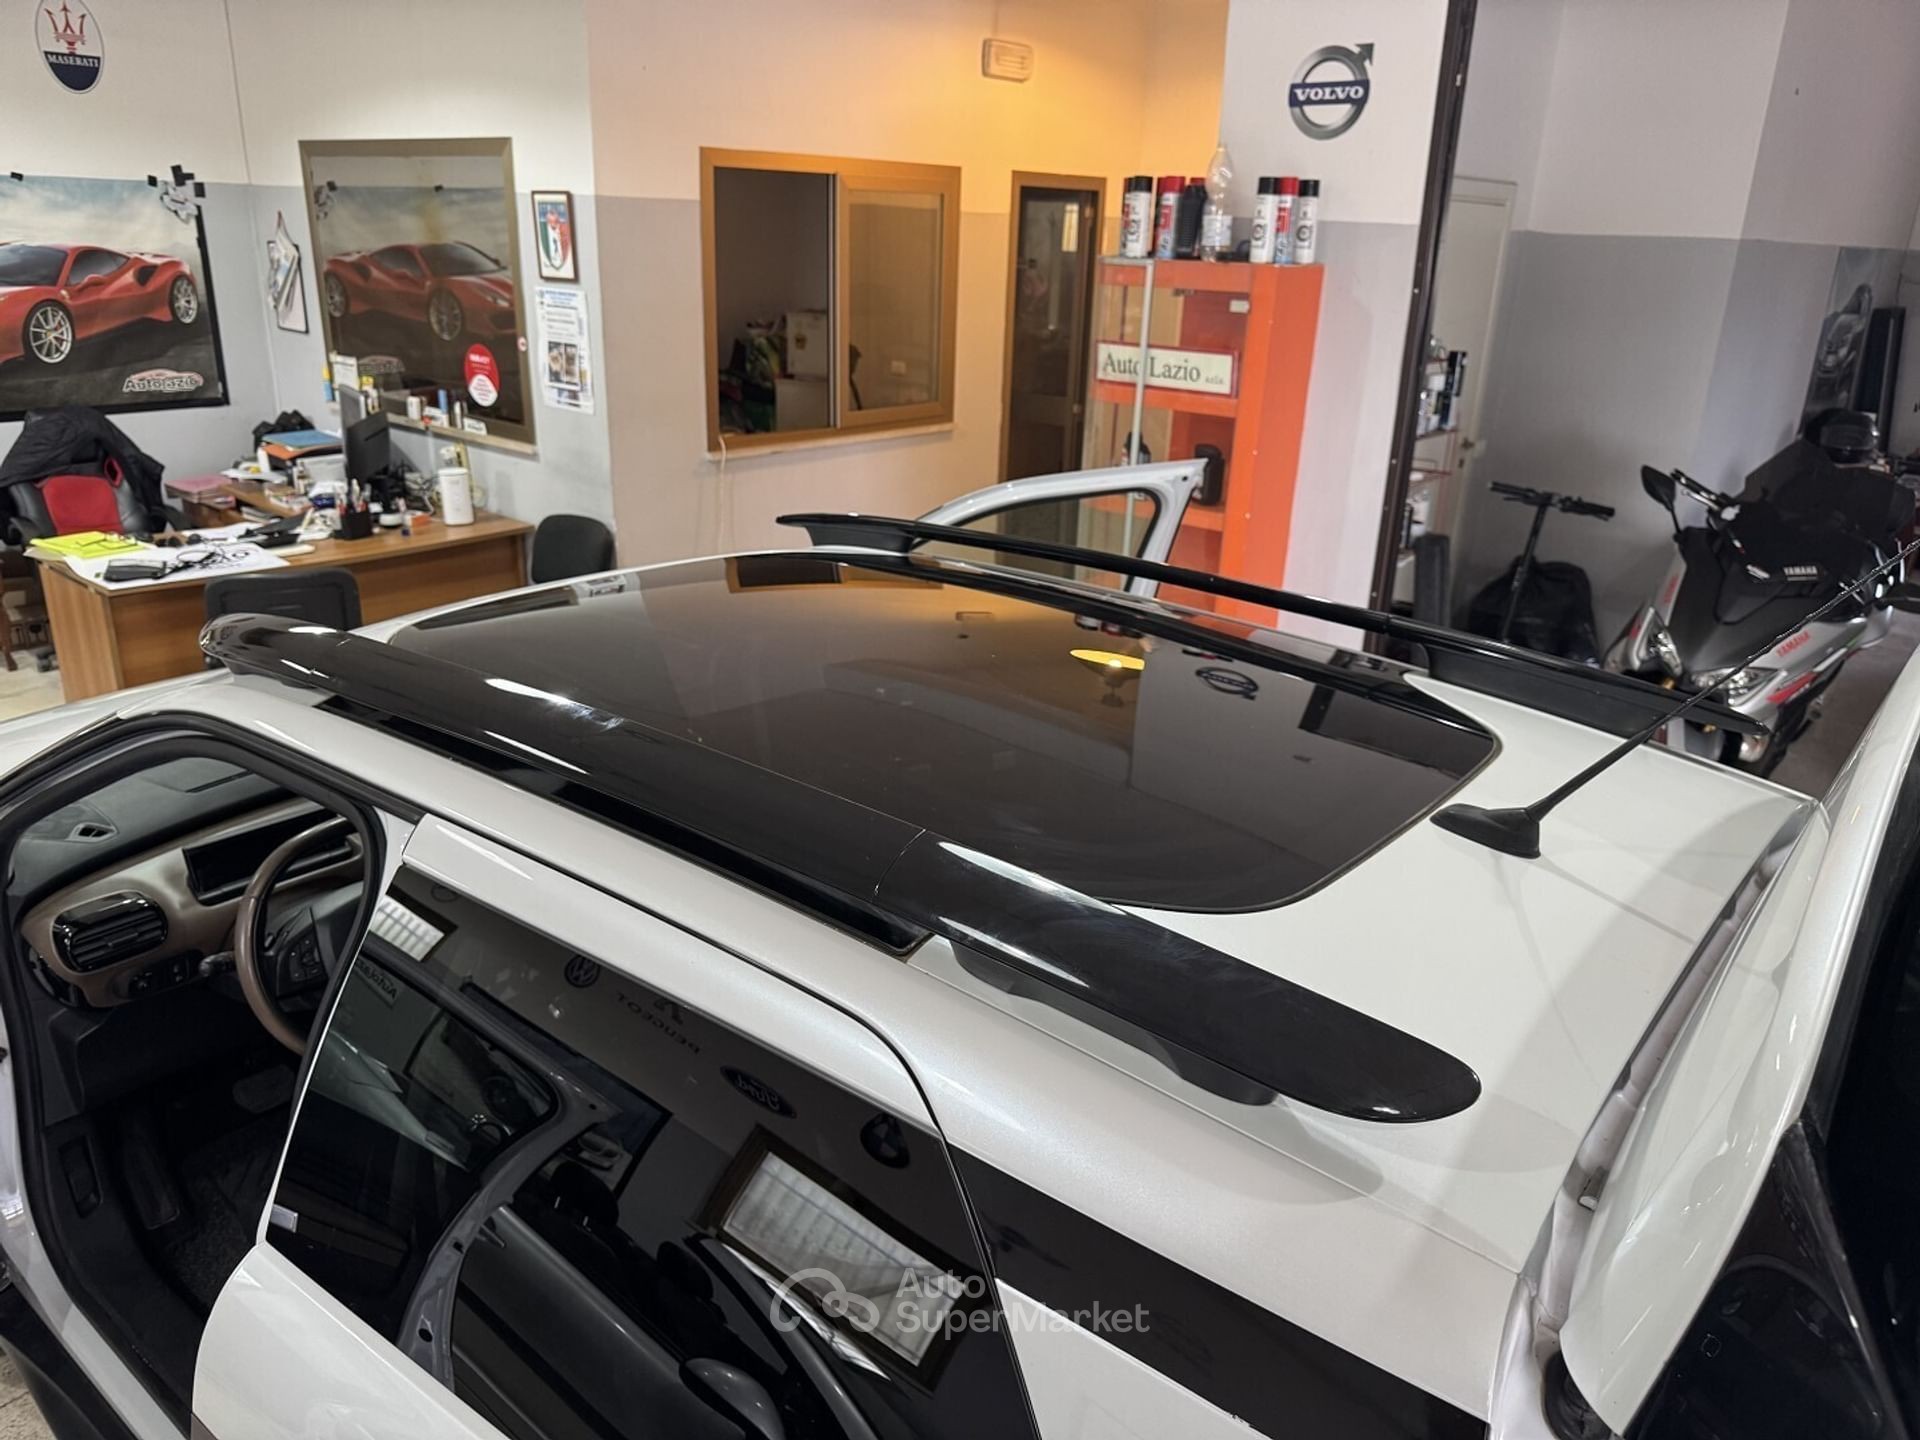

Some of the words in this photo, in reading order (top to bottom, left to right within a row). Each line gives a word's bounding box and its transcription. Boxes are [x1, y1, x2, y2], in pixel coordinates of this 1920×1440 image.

[46, 53, 99, 67] MASERATI
[1293, 85, 1364, 101] VOLVO
[1150, 356, 1201, 382] Lazio
[1783, 565, 1818, 576] YAMAHA
